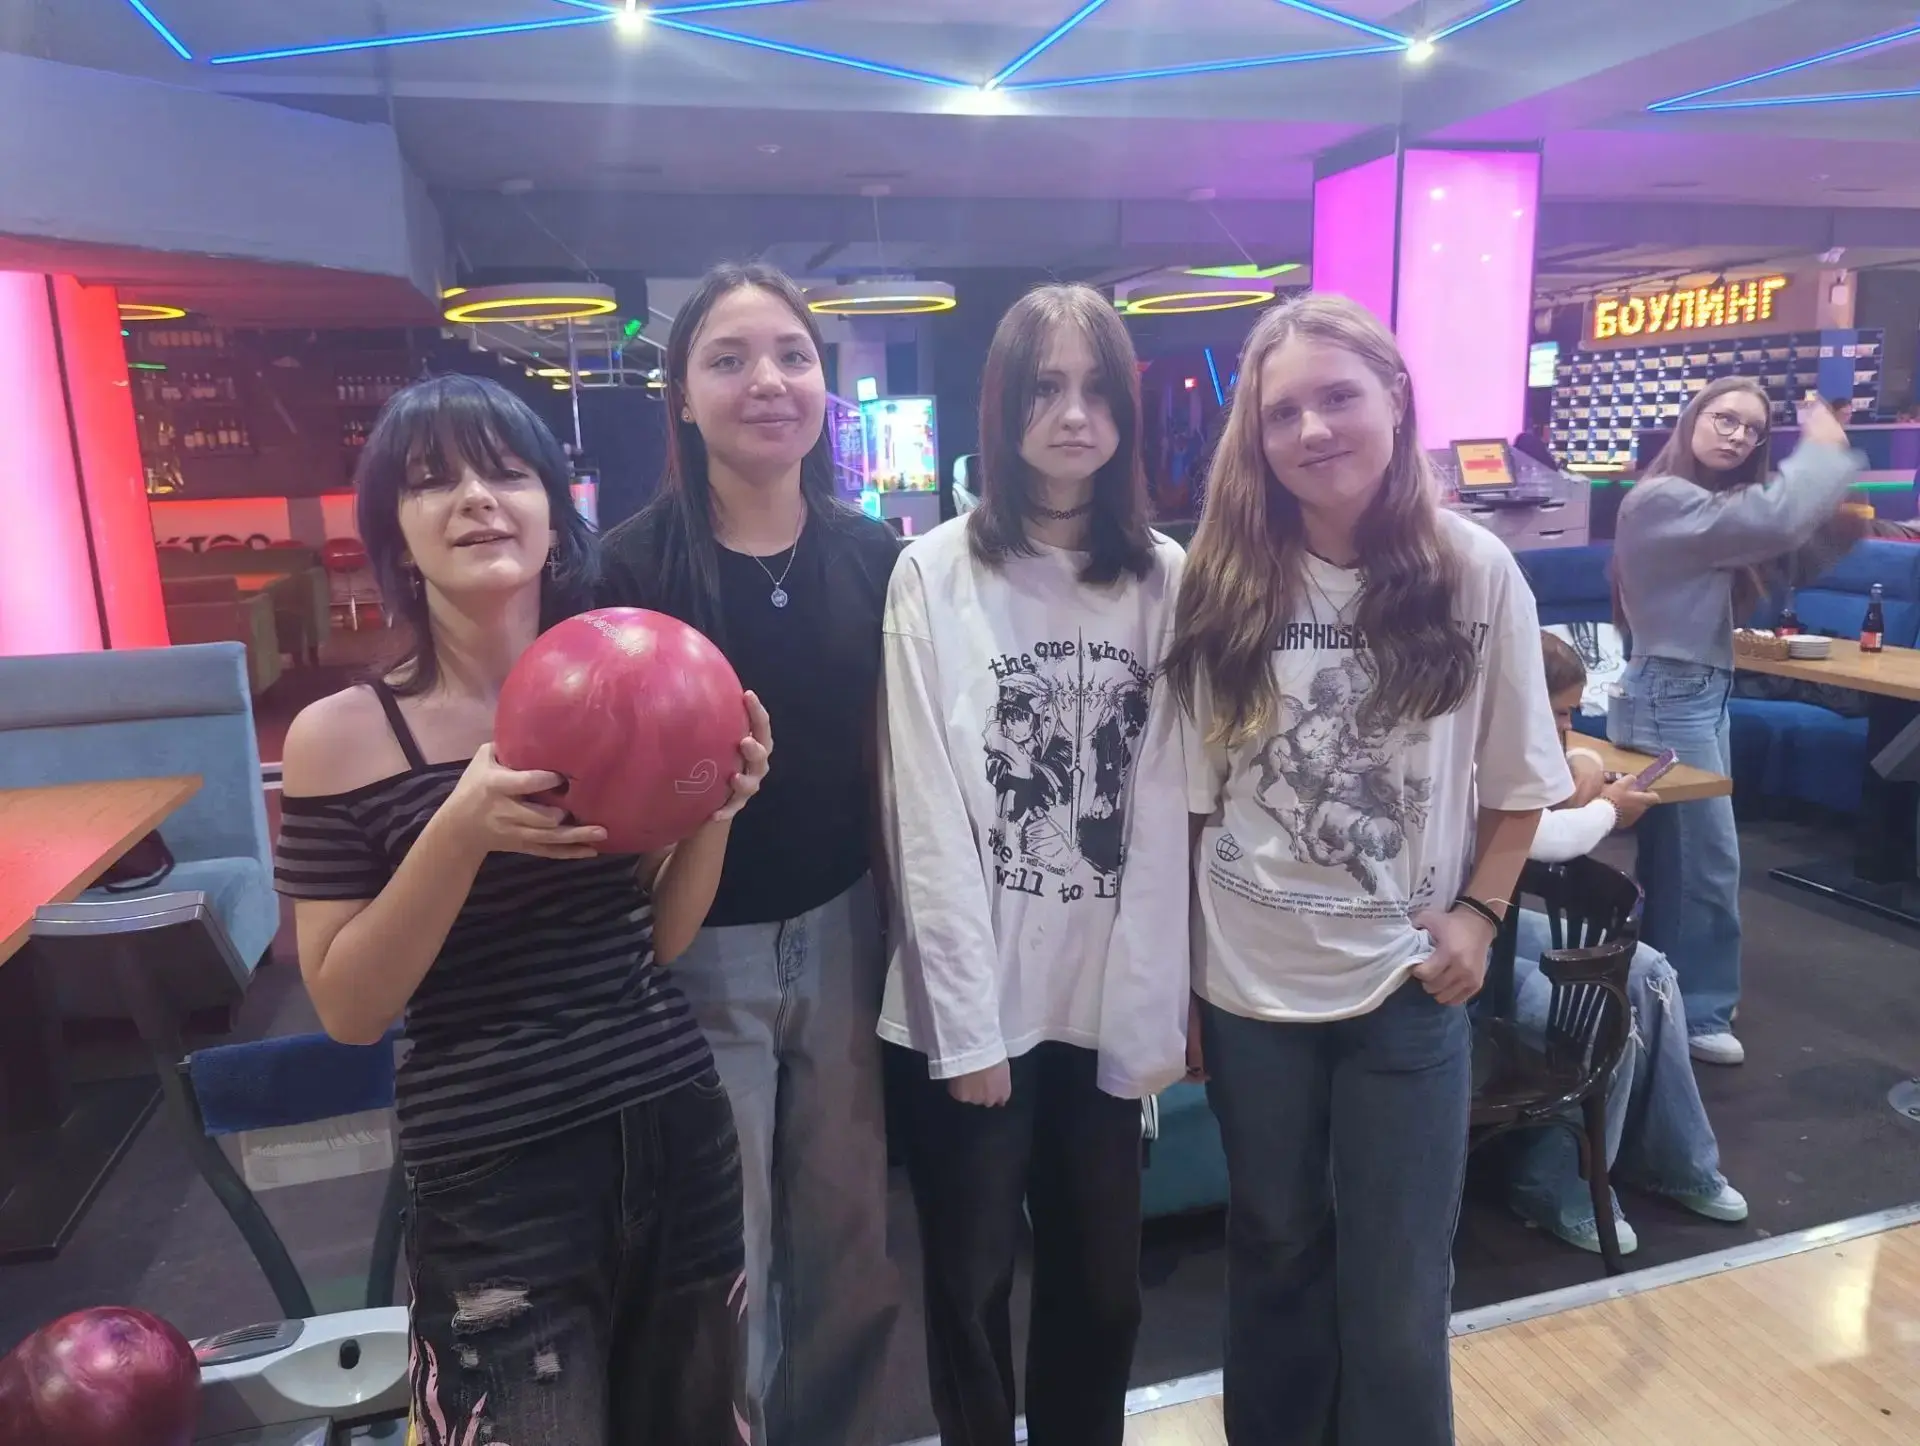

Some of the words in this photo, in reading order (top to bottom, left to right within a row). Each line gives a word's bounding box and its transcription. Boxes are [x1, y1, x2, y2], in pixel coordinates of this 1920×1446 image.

[1595, 274, 1787, 338] БОУЛИНГ
[988, 653, 1035, 679] the
[1034, 640, 1076, 659] one
[995, 865, 1044, 897] will
[1058, 883, 1083, 903] to
